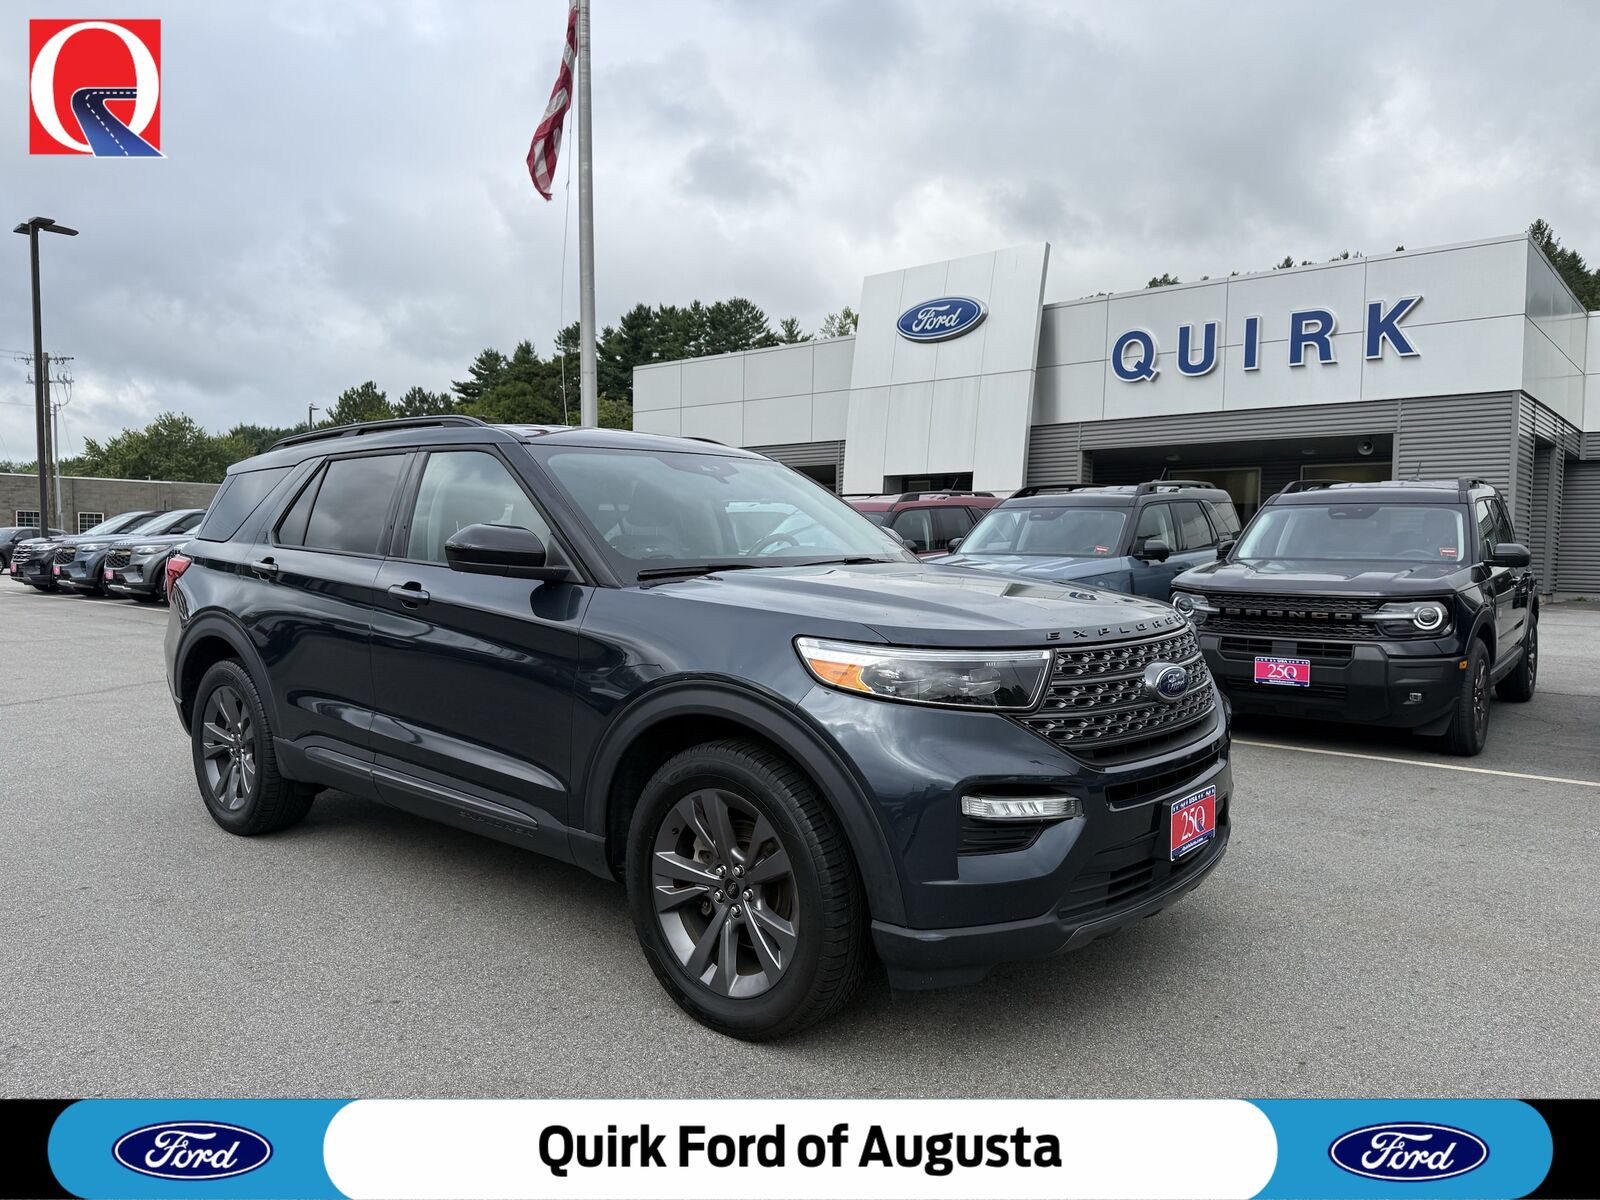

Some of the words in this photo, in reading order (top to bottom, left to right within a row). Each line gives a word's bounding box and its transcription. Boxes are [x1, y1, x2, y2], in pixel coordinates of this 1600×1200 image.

[911, 304, 963, 333] Ford
[1111, 295, 1424, 383] QUIRK
[1225, 607, 1353, 620] BRONCO
